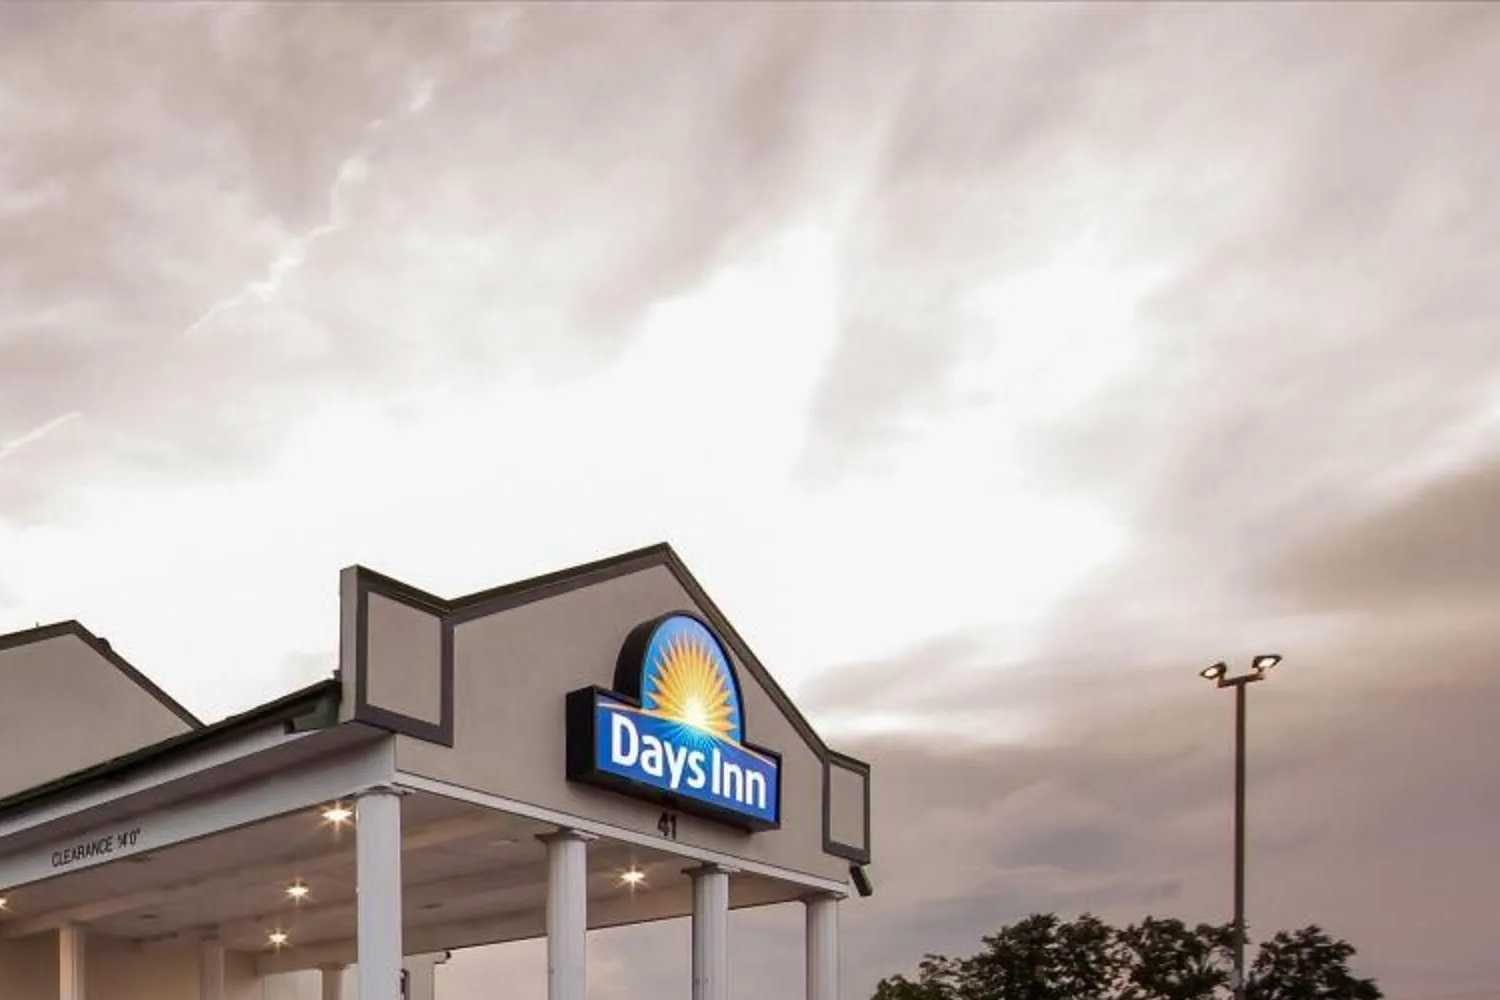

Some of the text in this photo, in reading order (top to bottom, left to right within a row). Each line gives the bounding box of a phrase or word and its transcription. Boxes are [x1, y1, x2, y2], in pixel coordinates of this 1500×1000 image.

[611, 712, 767, 810] Days Inn
[657, 811, 677, 840] 41
[51, 835, 114, 868] CLEARANCE
